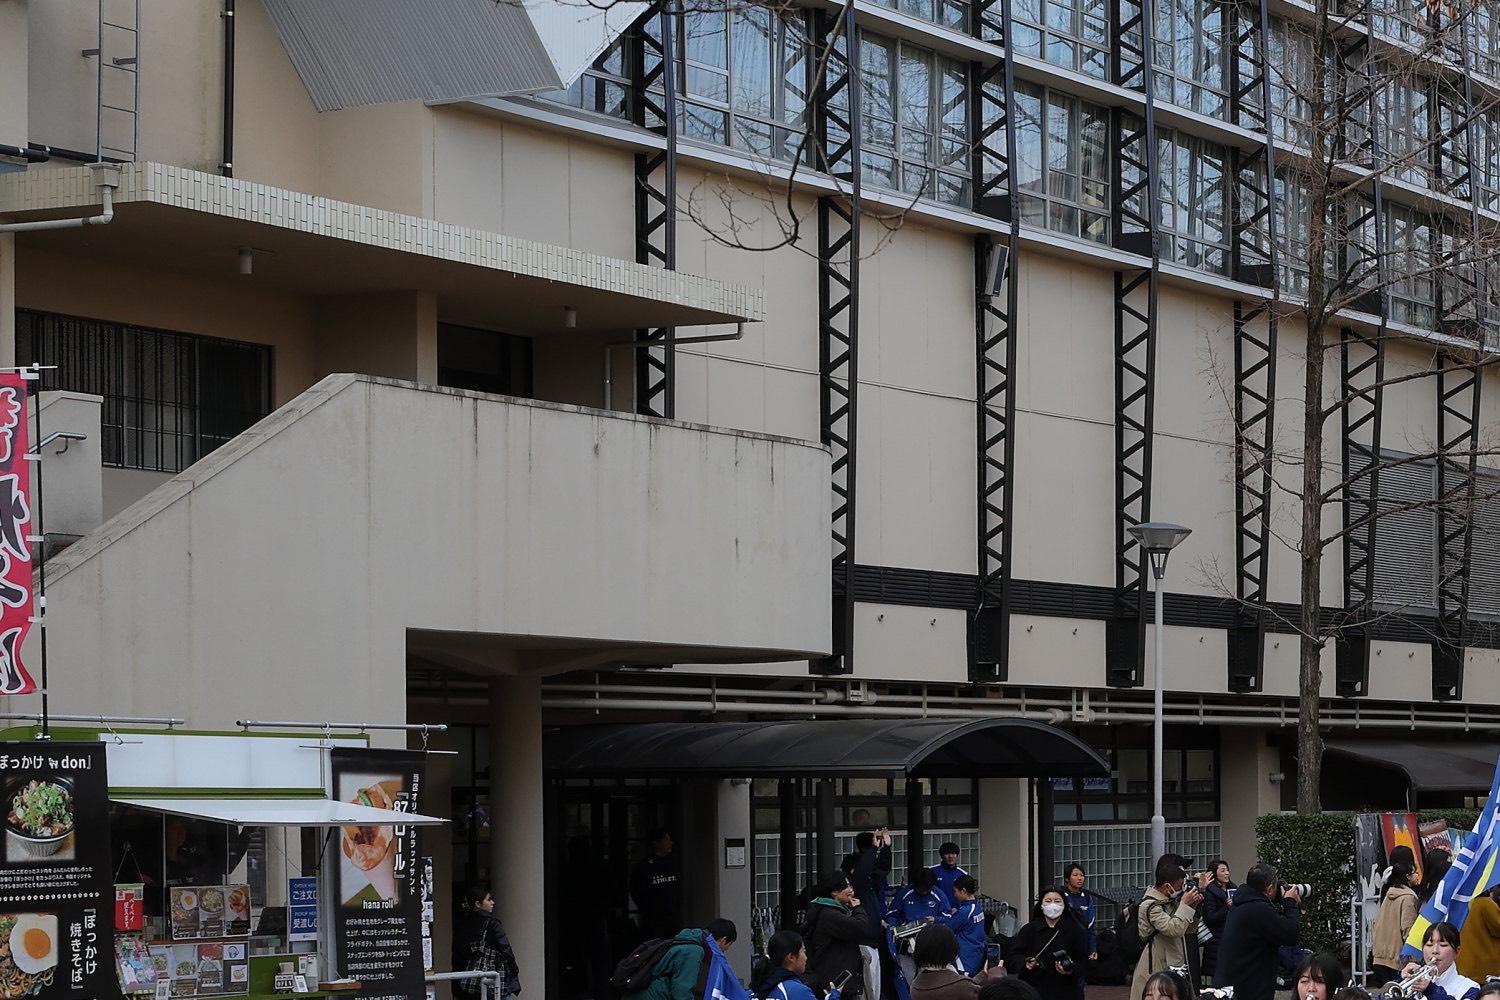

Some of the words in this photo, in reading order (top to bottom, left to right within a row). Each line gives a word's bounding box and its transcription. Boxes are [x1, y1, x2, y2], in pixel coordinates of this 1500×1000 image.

[409, 774, 420, 895] 当店オリルラップサンド
[363, 900, 381, 909] hana
[382, 898, 394, 909] roll
[70, 923, 84, 990] 焼きそば』
[84, 908, 98, 975] 『ぼっかけ
